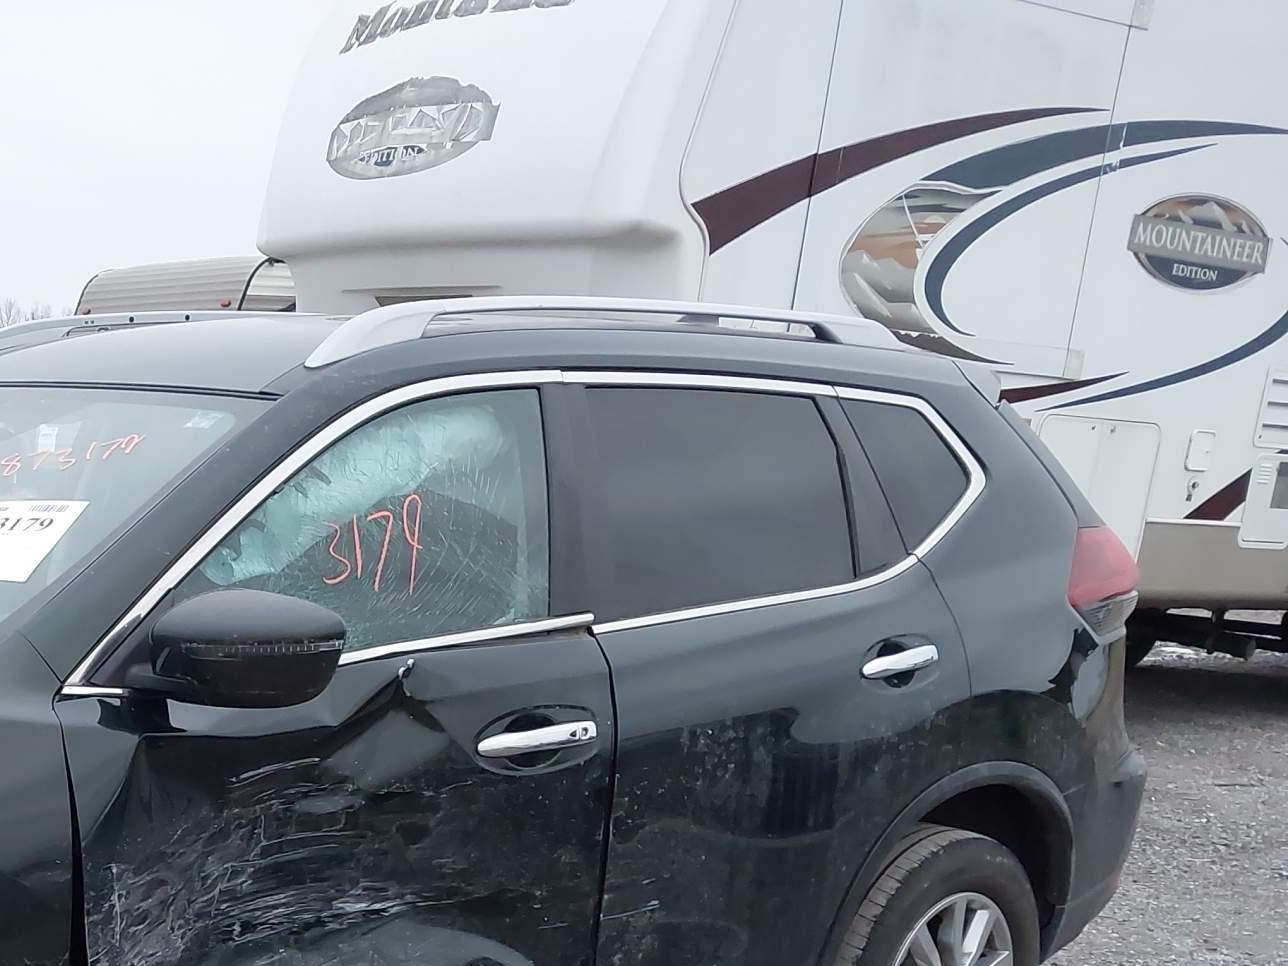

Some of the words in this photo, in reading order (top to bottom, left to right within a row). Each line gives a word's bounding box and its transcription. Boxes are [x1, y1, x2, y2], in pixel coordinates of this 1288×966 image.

[1133, 221, 1264, 265] MOUNTAINEER
[1171, 263, 1218, 281] EDITION
[321, 493, 424, 596] 3179
